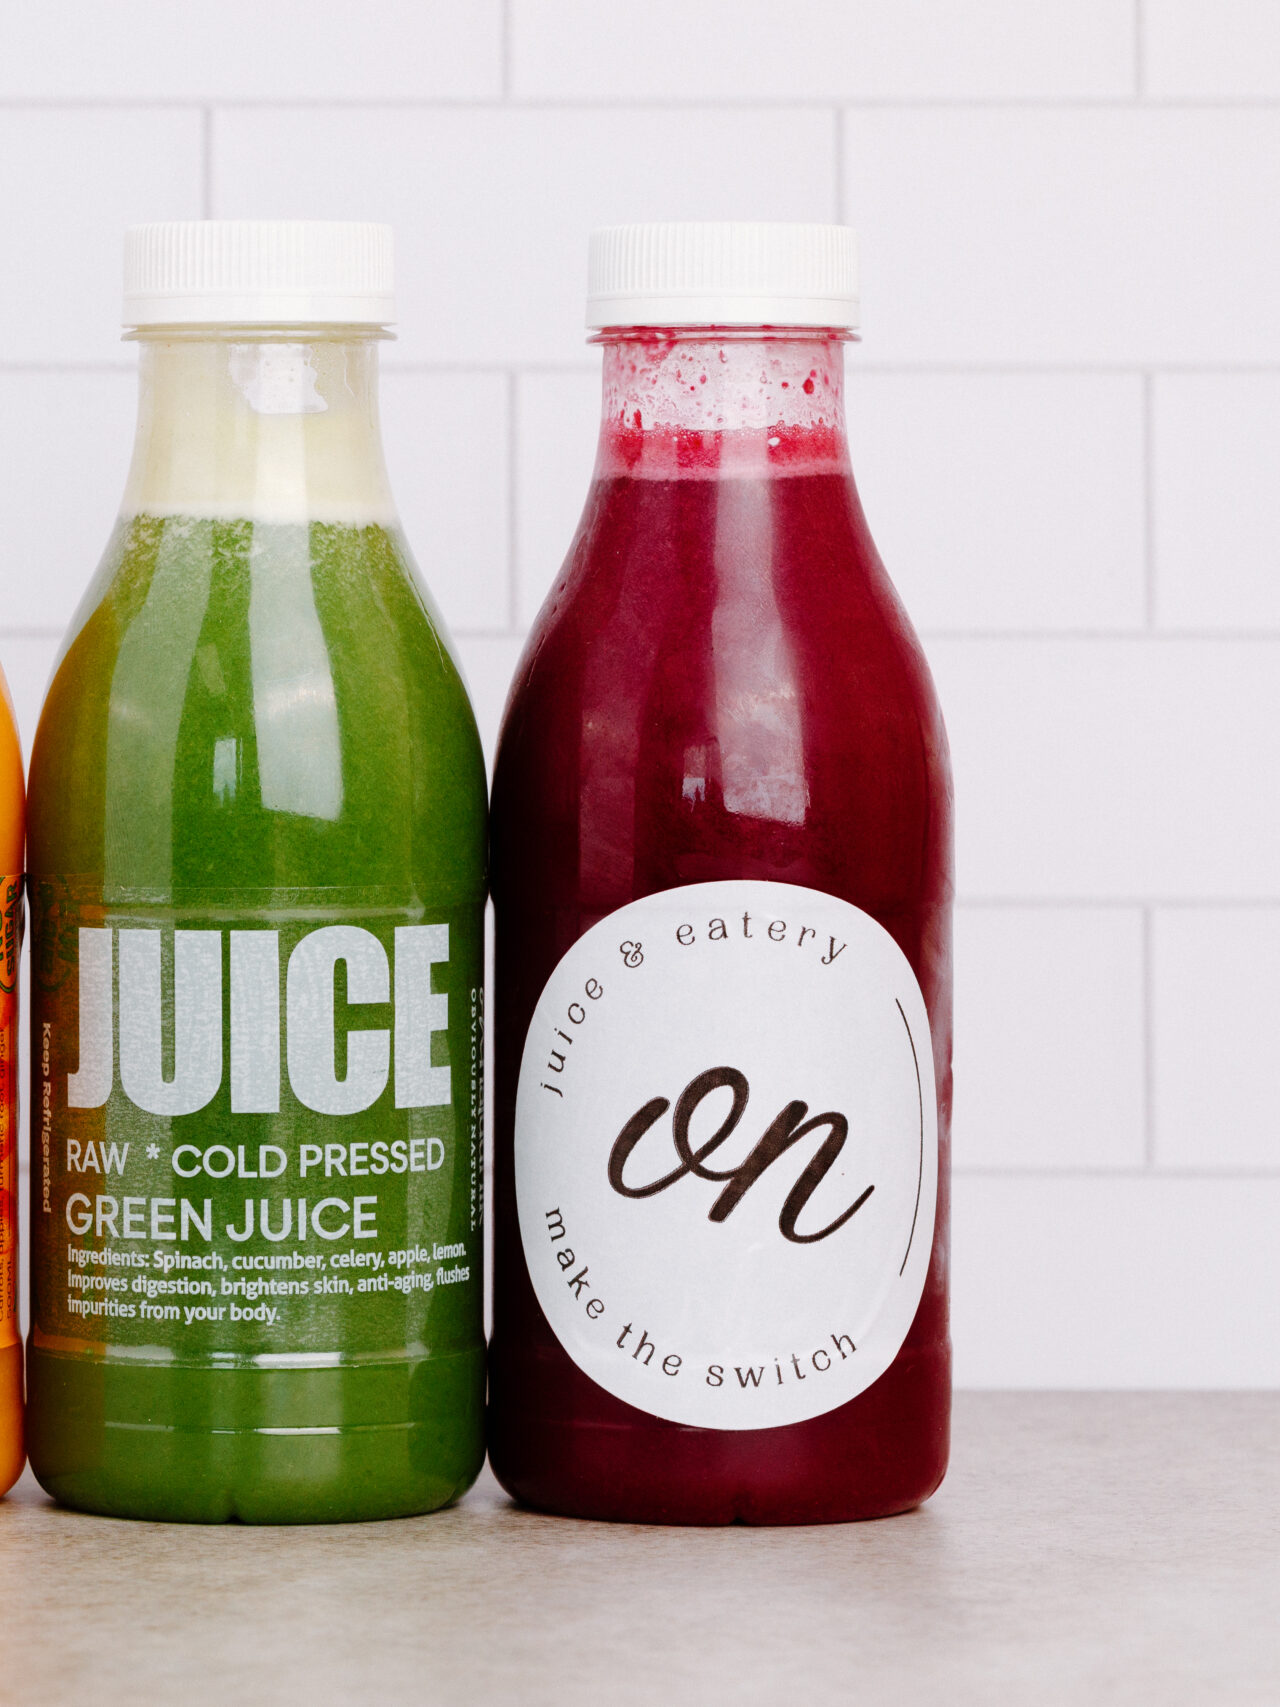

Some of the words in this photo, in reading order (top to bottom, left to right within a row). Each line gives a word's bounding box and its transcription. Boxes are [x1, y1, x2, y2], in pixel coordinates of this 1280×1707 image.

[67, 923, 452, 1117] JUICE
[539, 976, 604, 1097] juice
[619, 940, 645, 968] &
[675, 910, 848, 966] eatery
[41, 1022, 52, 1077] Keep
[41, 1081, 52, 1213] Refrigerated
[67, 1138, 129, 1175] RAW
[171, 1144, 288, 1179] COLD
[300, 1137, 445, 1178] PRESSED
[607, 1065, 875, 1245] on
[66, 1192, 213, 1242] GREEN
[226, 1195, 379, 1242] JUICE
[67, 1243, 150, 1268] Ingredients:
[153, 1250, 228, 1274] Spinach,
[232, 1251, 326, 1271] cucumber,
[330, 1249, 385, 1271] celery,
[388, 1244, 430, 1269] apple,
[433, 1242, 466, 1261] lemon.
[67, 1269, 128, 1293] Improves
[132, 1275, 216, 1298] digestion,
[221, 1276, 309, 1300] brightens
[314, 1275, 354, 1295] skin,
[357, 1270, 434, 1294] anti-aging,
[436, 1264, 470, 1286] flushes
[67, 1294, 136, 1319] impurities
[139, 1300, 180, 1320] from
[184, 1306, 226, 1325] your
[230, 1302, 281, 1325] body.
[545, 1206, 606, 1321] make
[615, 1322, 684, 1378] the
[704, 1332, 857, 1390] switch
